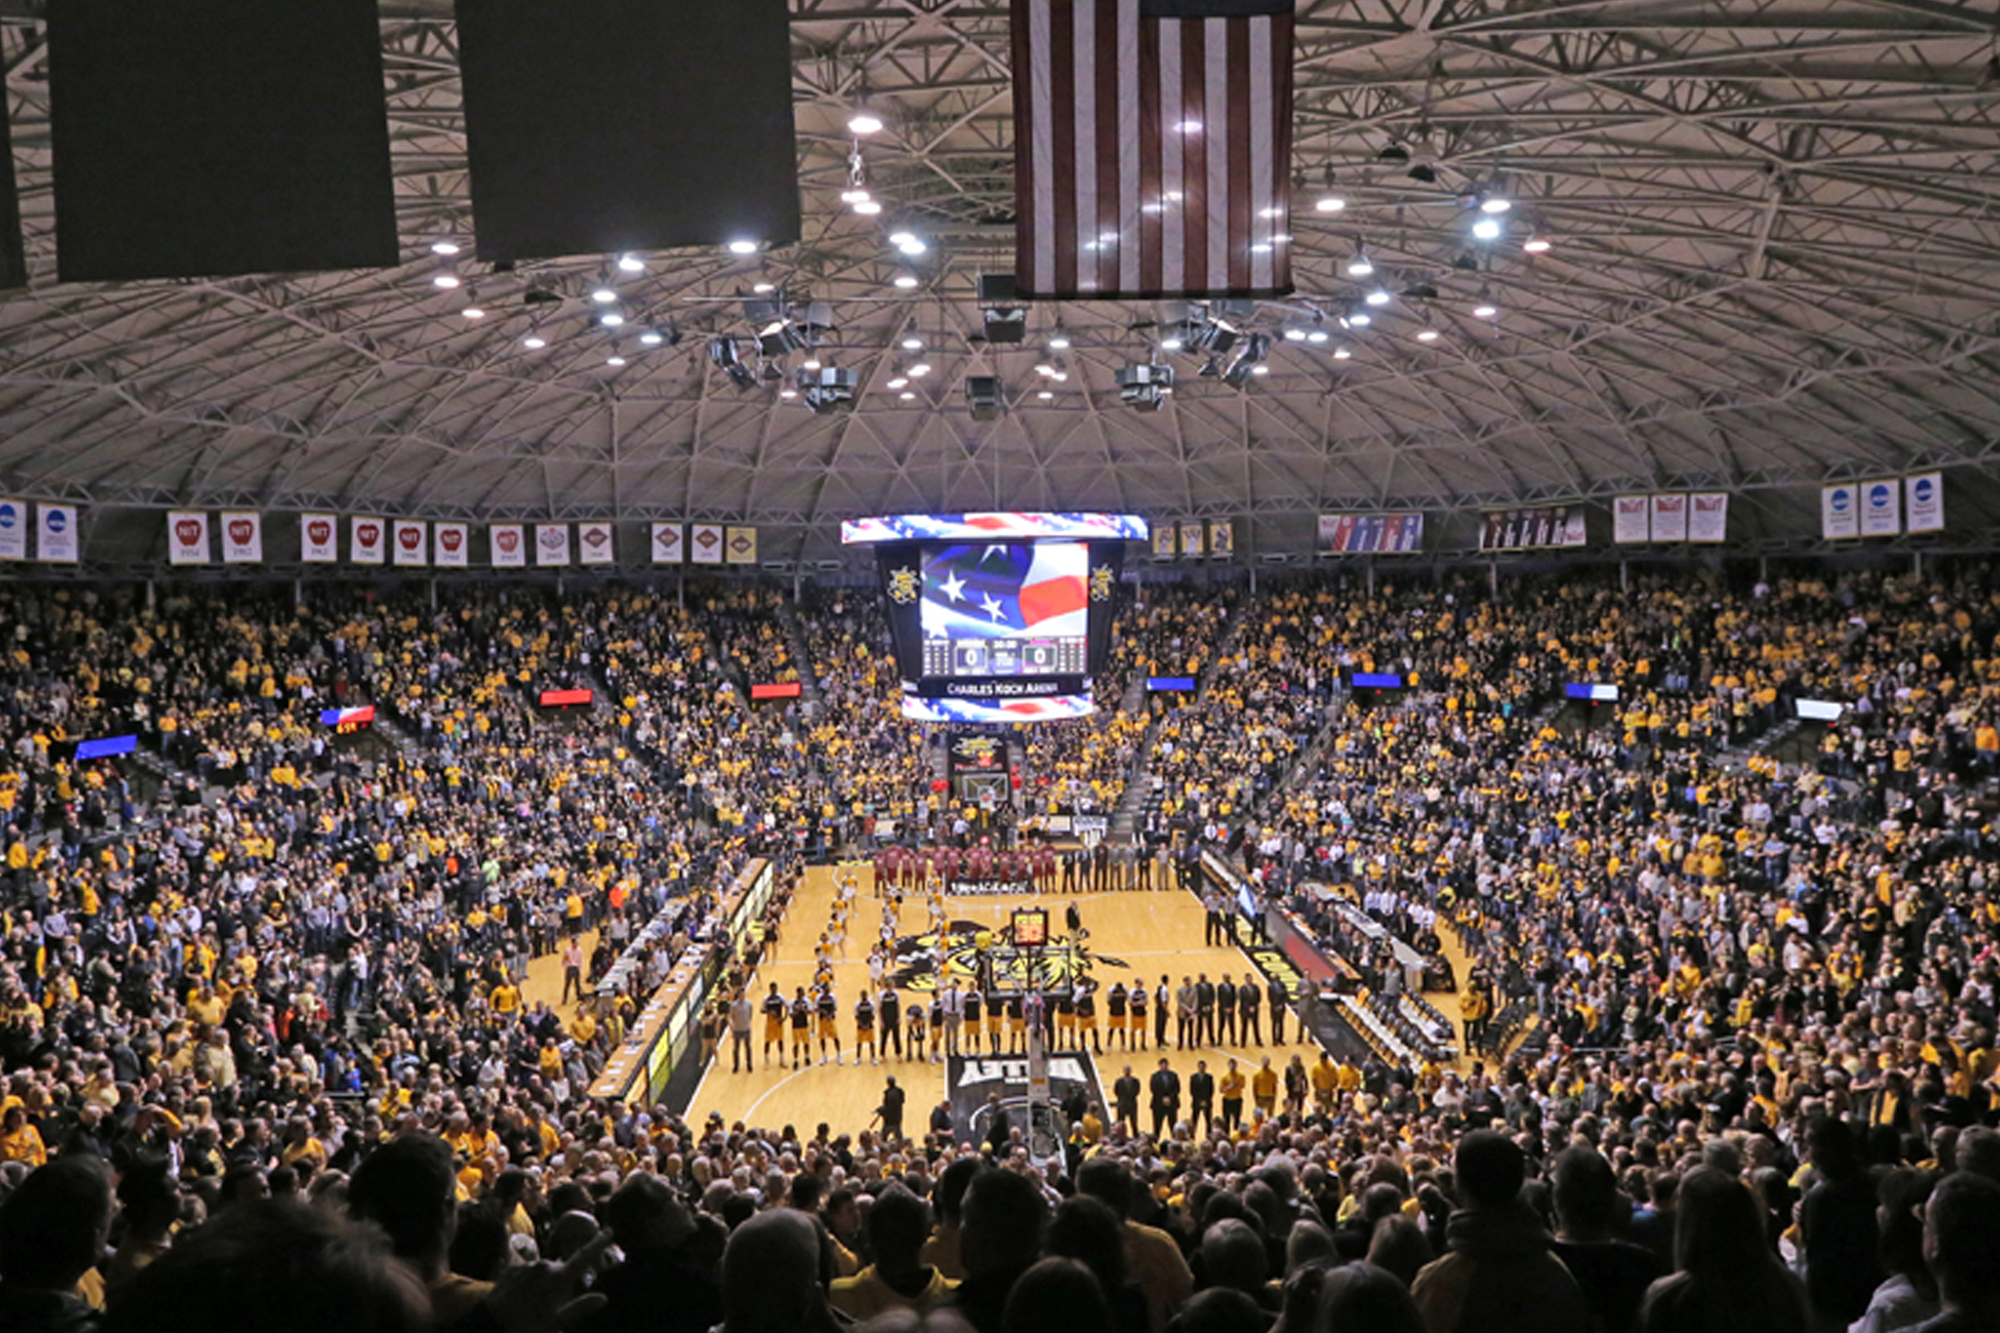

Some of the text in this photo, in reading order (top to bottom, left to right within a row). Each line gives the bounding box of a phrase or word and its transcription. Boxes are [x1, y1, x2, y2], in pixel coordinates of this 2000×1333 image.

[179, 525, 198, 537] NIT
[231, 525, 250, 537] NIT
[310, 526, 328, 537] NIT
[965, 649, 977, 666] 0
[1034, 648, 1046, 665] 0
